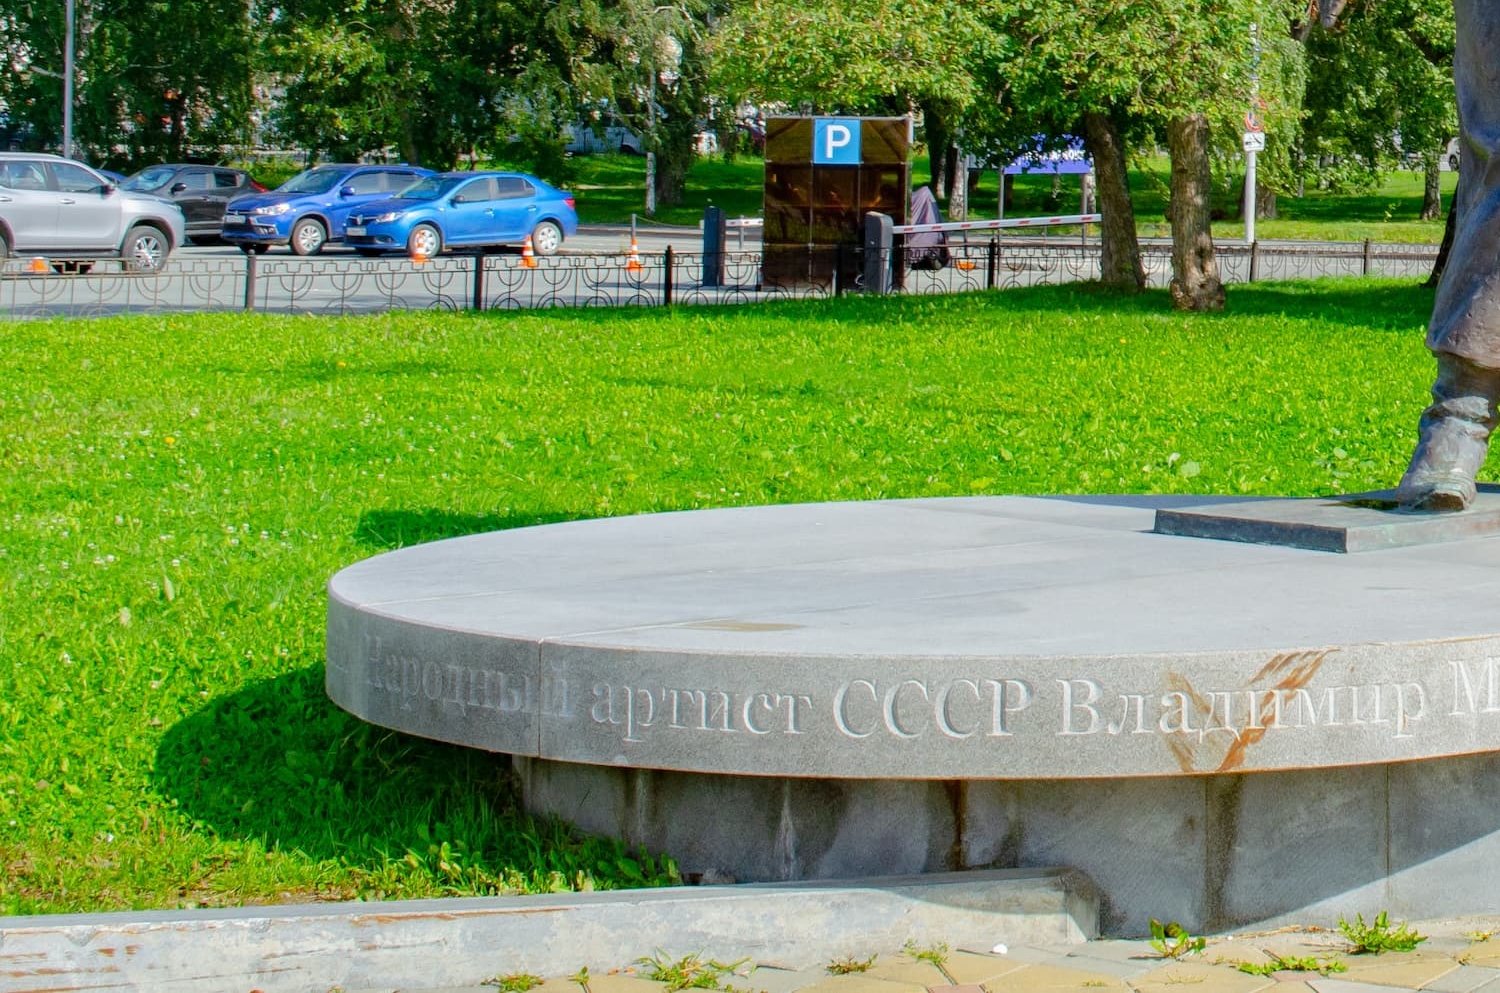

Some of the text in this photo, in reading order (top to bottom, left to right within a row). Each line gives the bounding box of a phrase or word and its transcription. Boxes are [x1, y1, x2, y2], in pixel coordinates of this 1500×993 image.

[826, 124, 851, 159] P
[591, 679, 812, 743] артист
[833, 678, 1034, 739] СССР
[1055, 678, 1426, 744] Владимир
